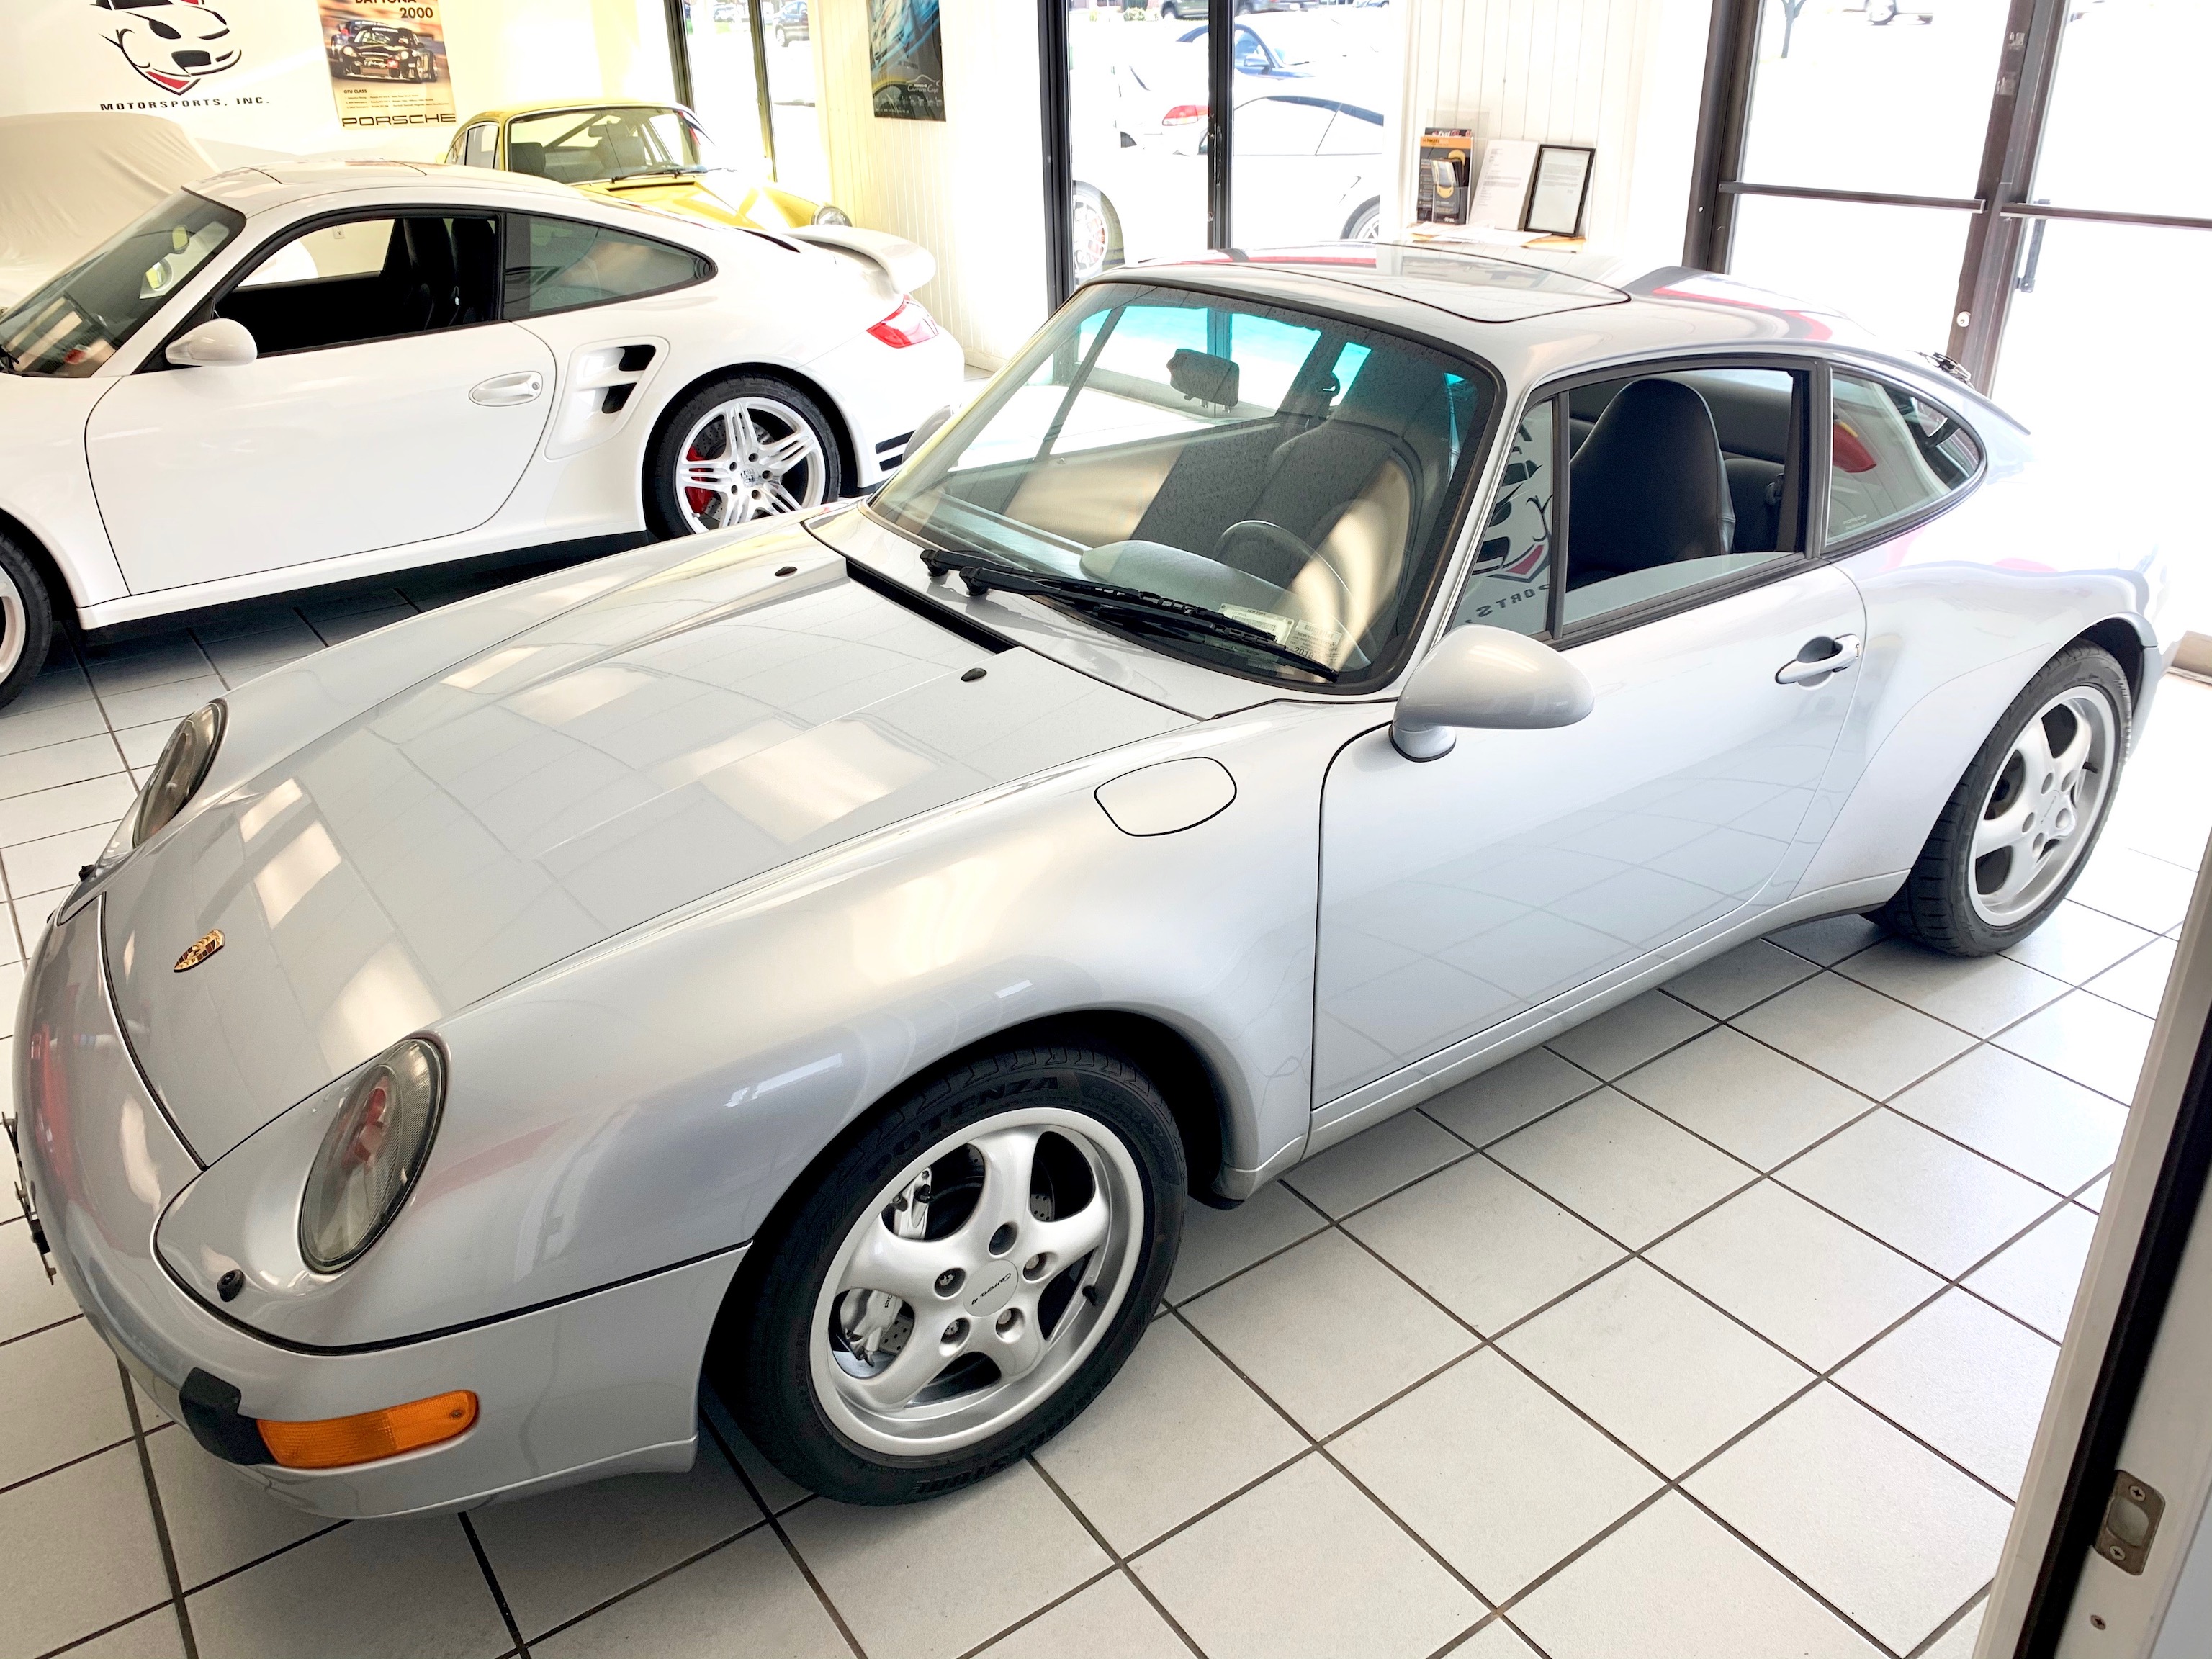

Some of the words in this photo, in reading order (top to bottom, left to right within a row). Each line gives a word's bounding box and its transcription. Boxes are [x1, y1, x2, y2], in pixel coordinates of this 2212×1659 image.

[399, 7, 433, 19] 2000
[99, 99, 228, 111] MOTORSPORTS,
[236, 96, 270, 105] INC.
[342, 113, 457, 127] PORSCHE
[1295, 647, 1313, 659] 2018
[865, 1076, 1059, 1183] POTENZA
[981, 1273, 1011, 1296] Carrera
